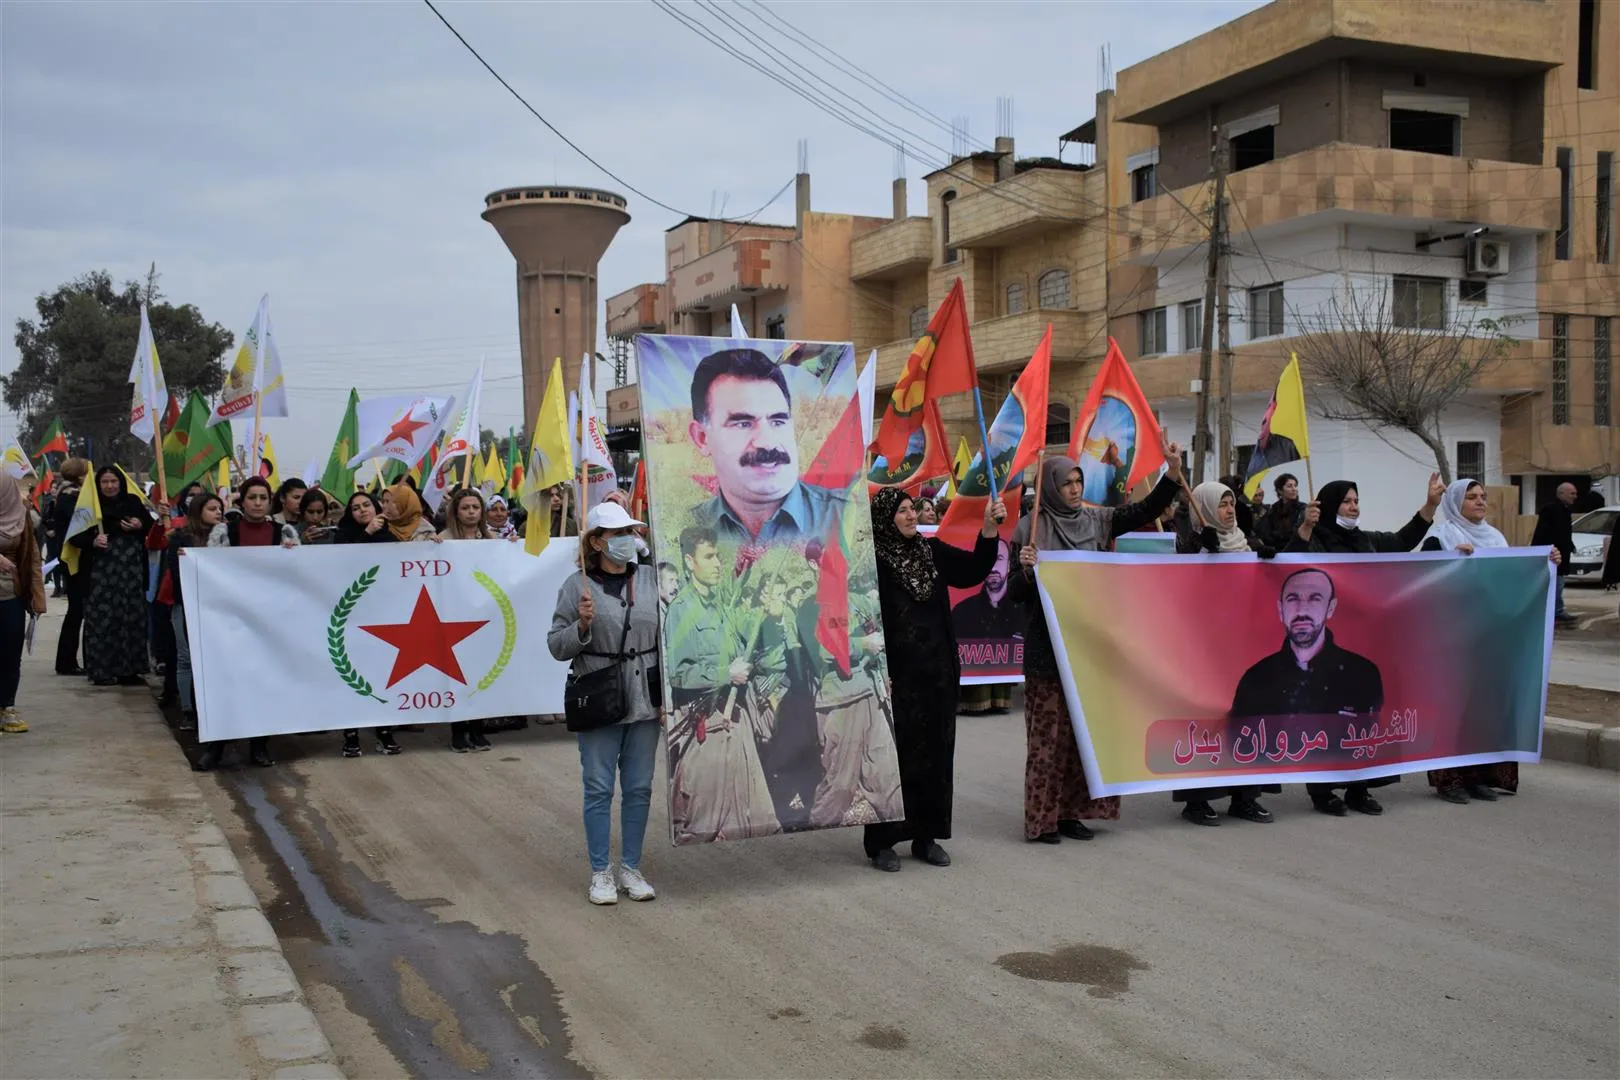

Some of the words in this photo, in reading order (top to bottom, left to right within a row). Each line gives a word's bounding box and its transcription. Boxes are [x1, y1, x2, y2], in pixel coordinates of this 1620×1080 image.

[400, 559, 452, 578] PYD
[397, 691, 456, 710] 2003
[1173, 721, 1223, 766] بدل
[1232, 718, 1329, 763] مروان
[1339, 708, 1418, 759] الشهيد
